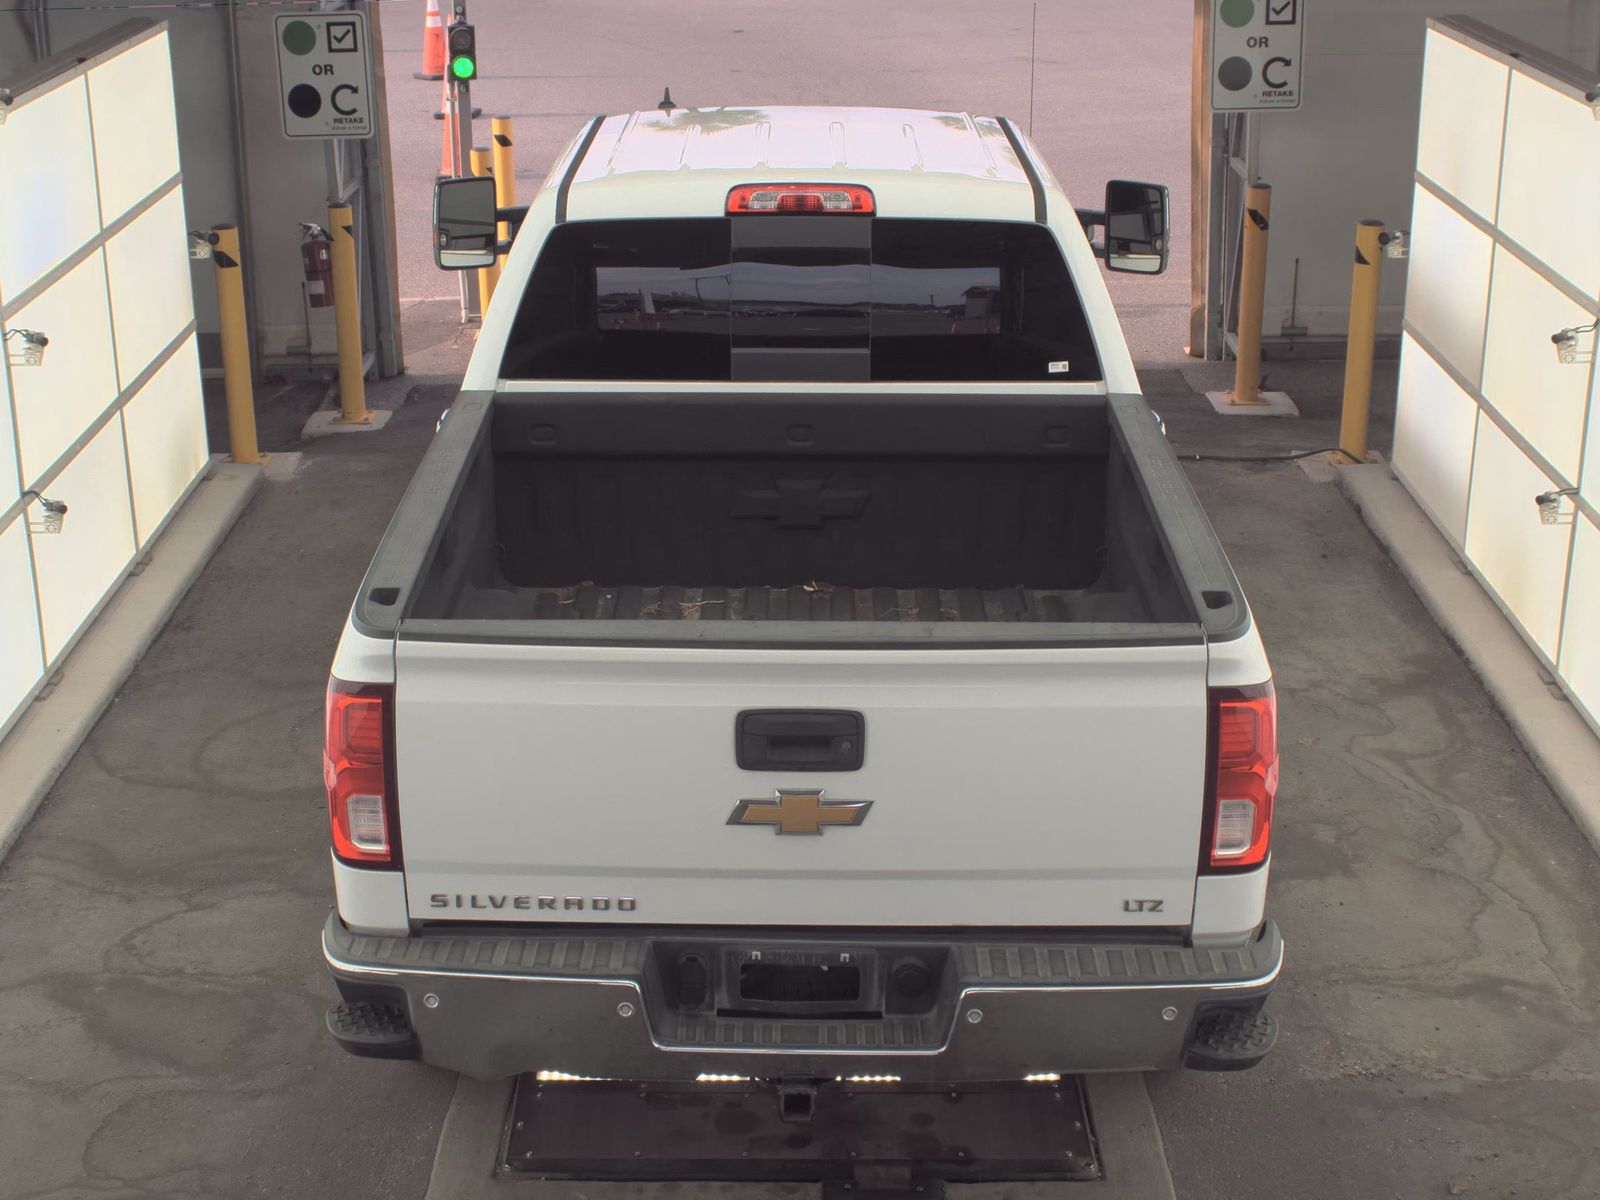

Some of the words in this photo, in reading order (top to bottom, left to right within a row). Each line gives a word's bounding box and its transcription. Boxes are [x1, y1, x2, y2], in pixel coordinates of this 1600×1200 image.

[1246, 36, 1269, 48] OR
[312, 64, 334, 75] OR
[430, 894, 636, 911] SILVERADO
[1123, 899, 1163, 912] LTZ
